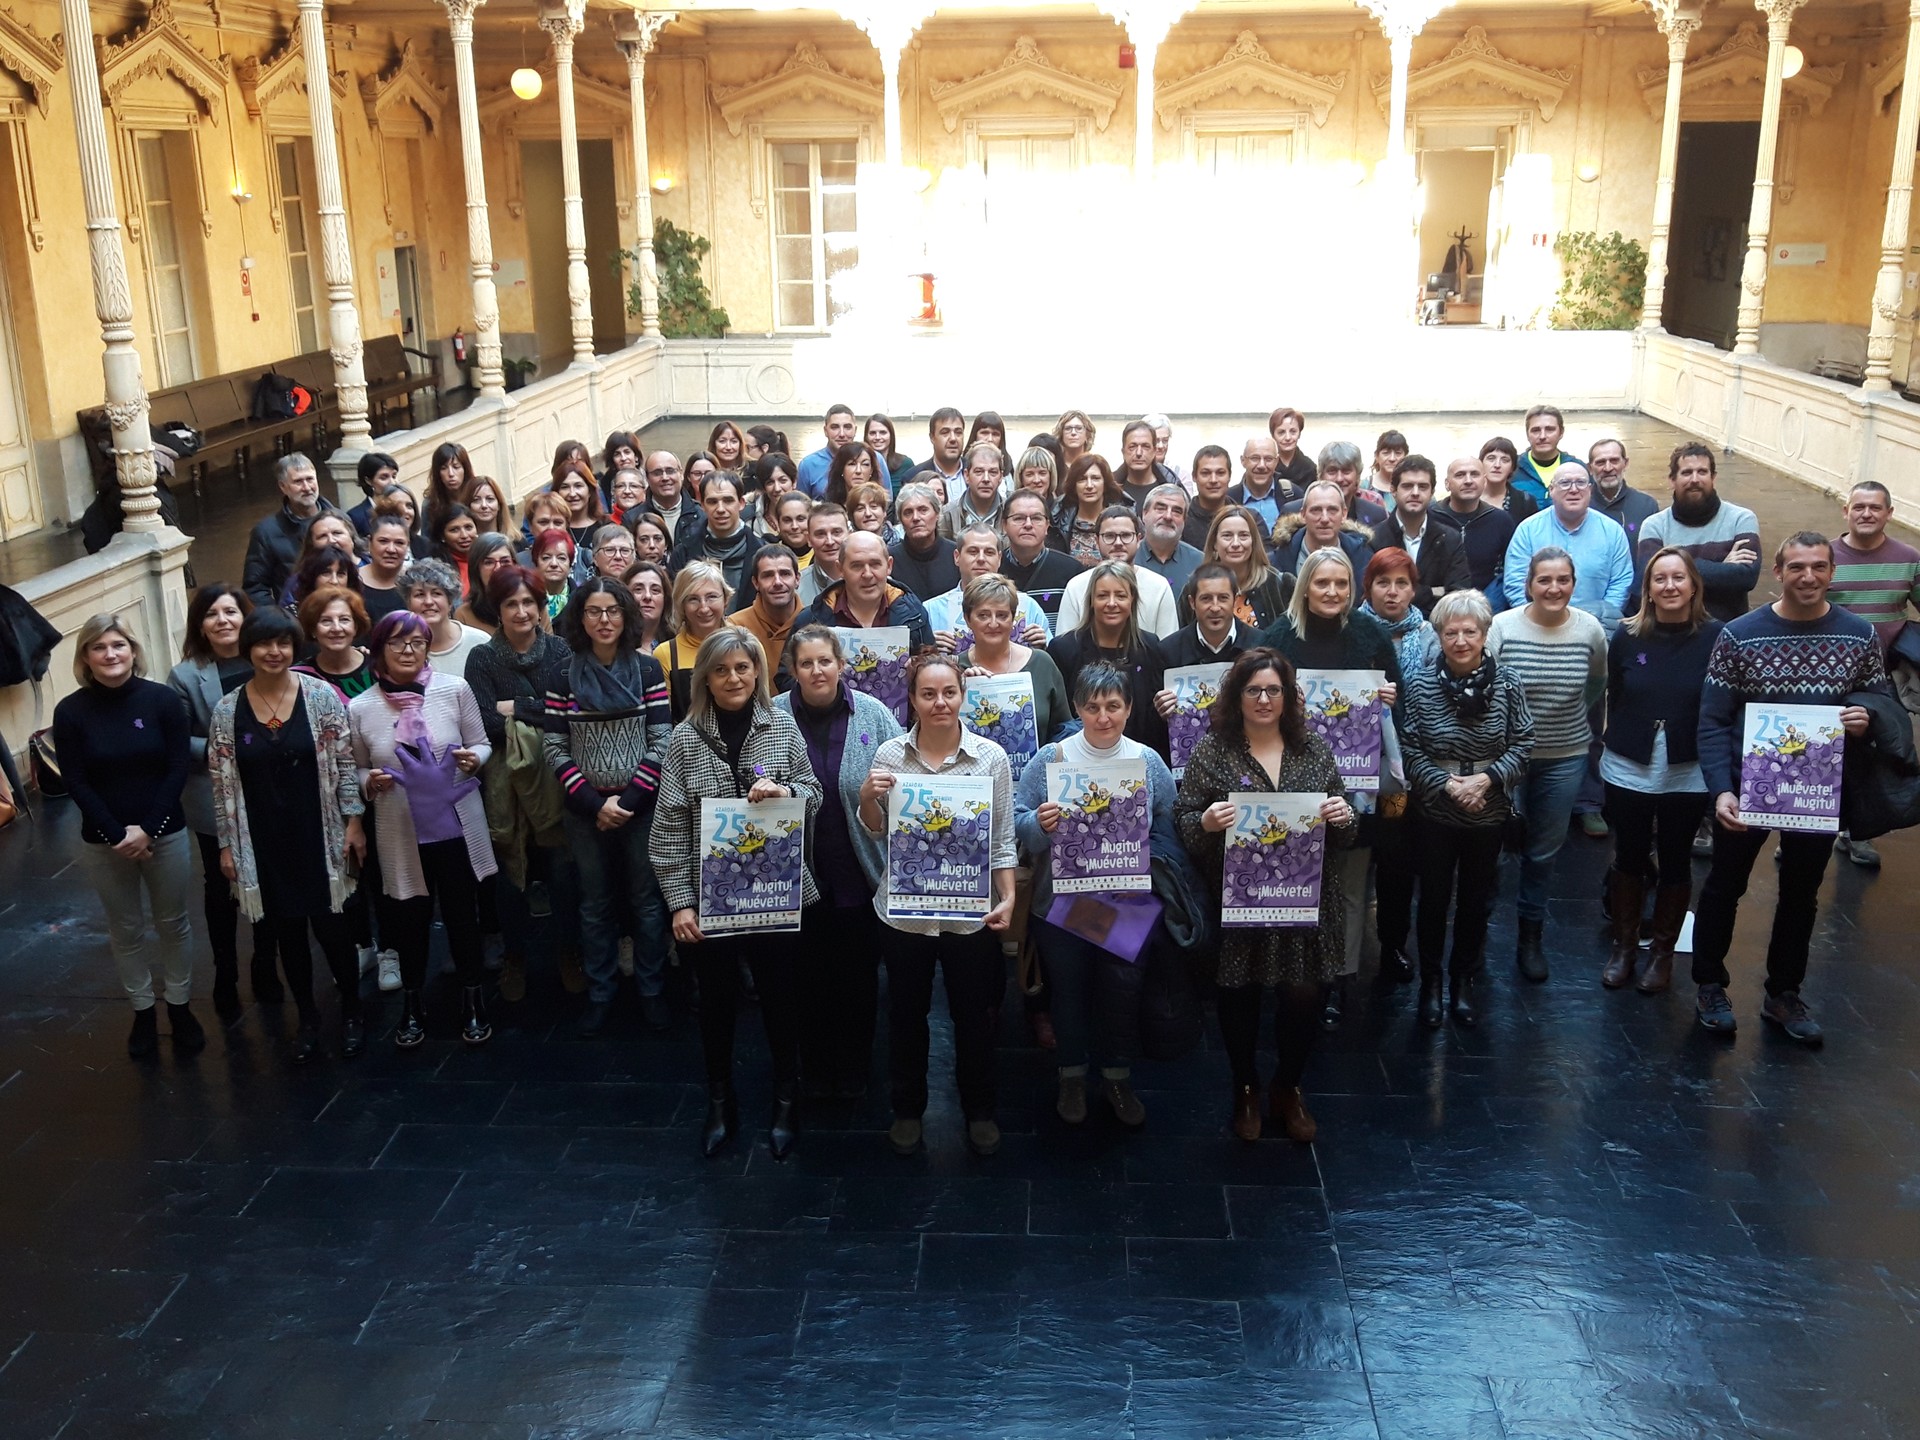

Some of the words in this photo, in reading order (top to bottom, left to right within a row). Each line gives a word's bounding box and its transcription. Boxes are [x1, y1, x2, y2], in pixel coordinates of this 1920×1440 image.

[1173, 676, 1199, 703] 25
[1305, 680, 1333, 706] 25
[1754, 714, 1788, 743] 25
[1008, 750, 1031, 766] gitu!
[1057, 773, 1089, 803] 25
[1777, 781, 1833, 797] ¡Muévete!
[899, 788, 933, 819] 25
[1793, 797, 1836, 812] Mugitu!
[1236, 804, 1270, 833] 25
[712, 813, 746, 843] 25
[1101, 839, 1142, 856] Mugitu!
[940, 862, 981, 878] Mugitu!
[1085, 855, 1140, 873] ¡Muévete!
[752, 878, 793, 895] Mugitu!
[923, 876, 979, 893] ¡Muévete!
[1257, 882, 1313, 900] ¡Muévete!
[735, 894, 790, 913] ¡Muévete!
